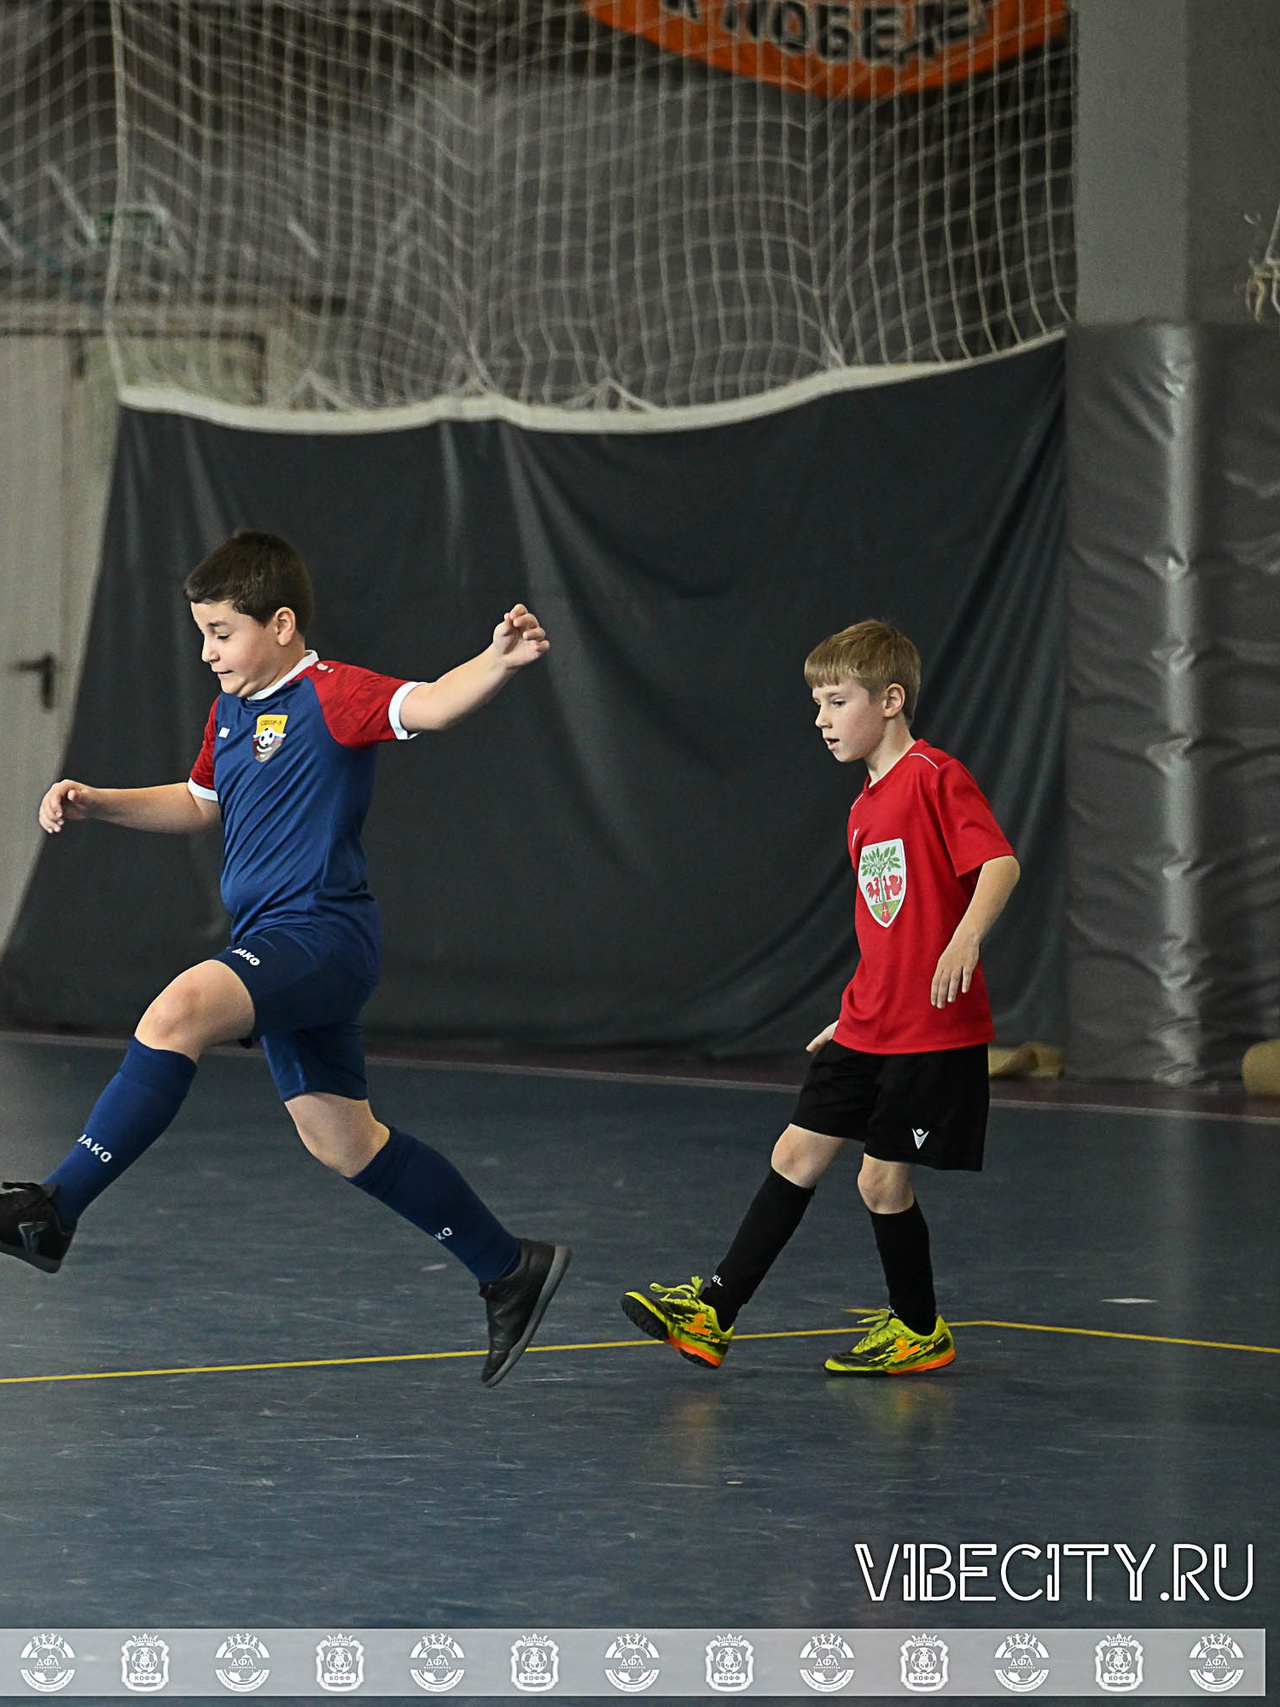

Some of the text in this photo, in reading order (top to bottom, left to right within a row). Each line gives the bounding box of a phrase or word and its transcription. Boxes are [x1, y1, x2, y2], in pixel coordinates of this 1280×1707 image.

[231, 948, 261, 966] JAKO
[77, 1133, 112, 1163] JAKO
[434, 1227, 453, 1241] KO
